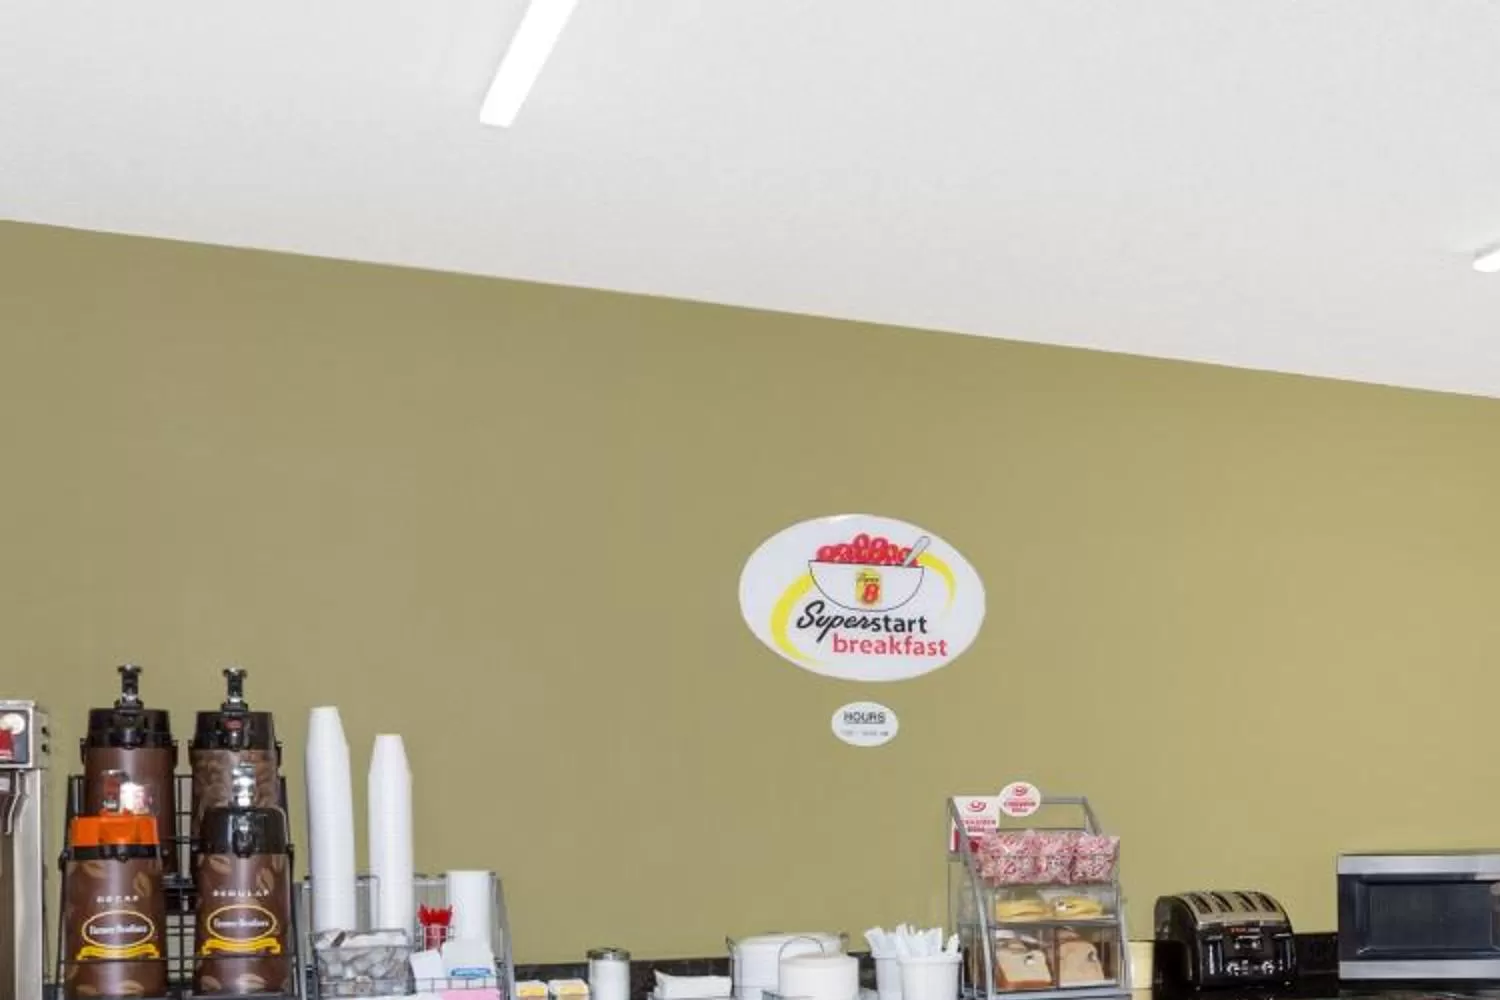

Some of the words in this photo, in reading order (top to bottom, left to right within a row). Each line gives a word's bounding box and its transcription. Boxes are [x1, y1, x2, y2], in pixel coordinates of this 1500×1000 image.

[796, 600, 928, 643] Superstart
[832, 633, 948, 657] breakfast
[844, 711, 886, 724] HOURS
